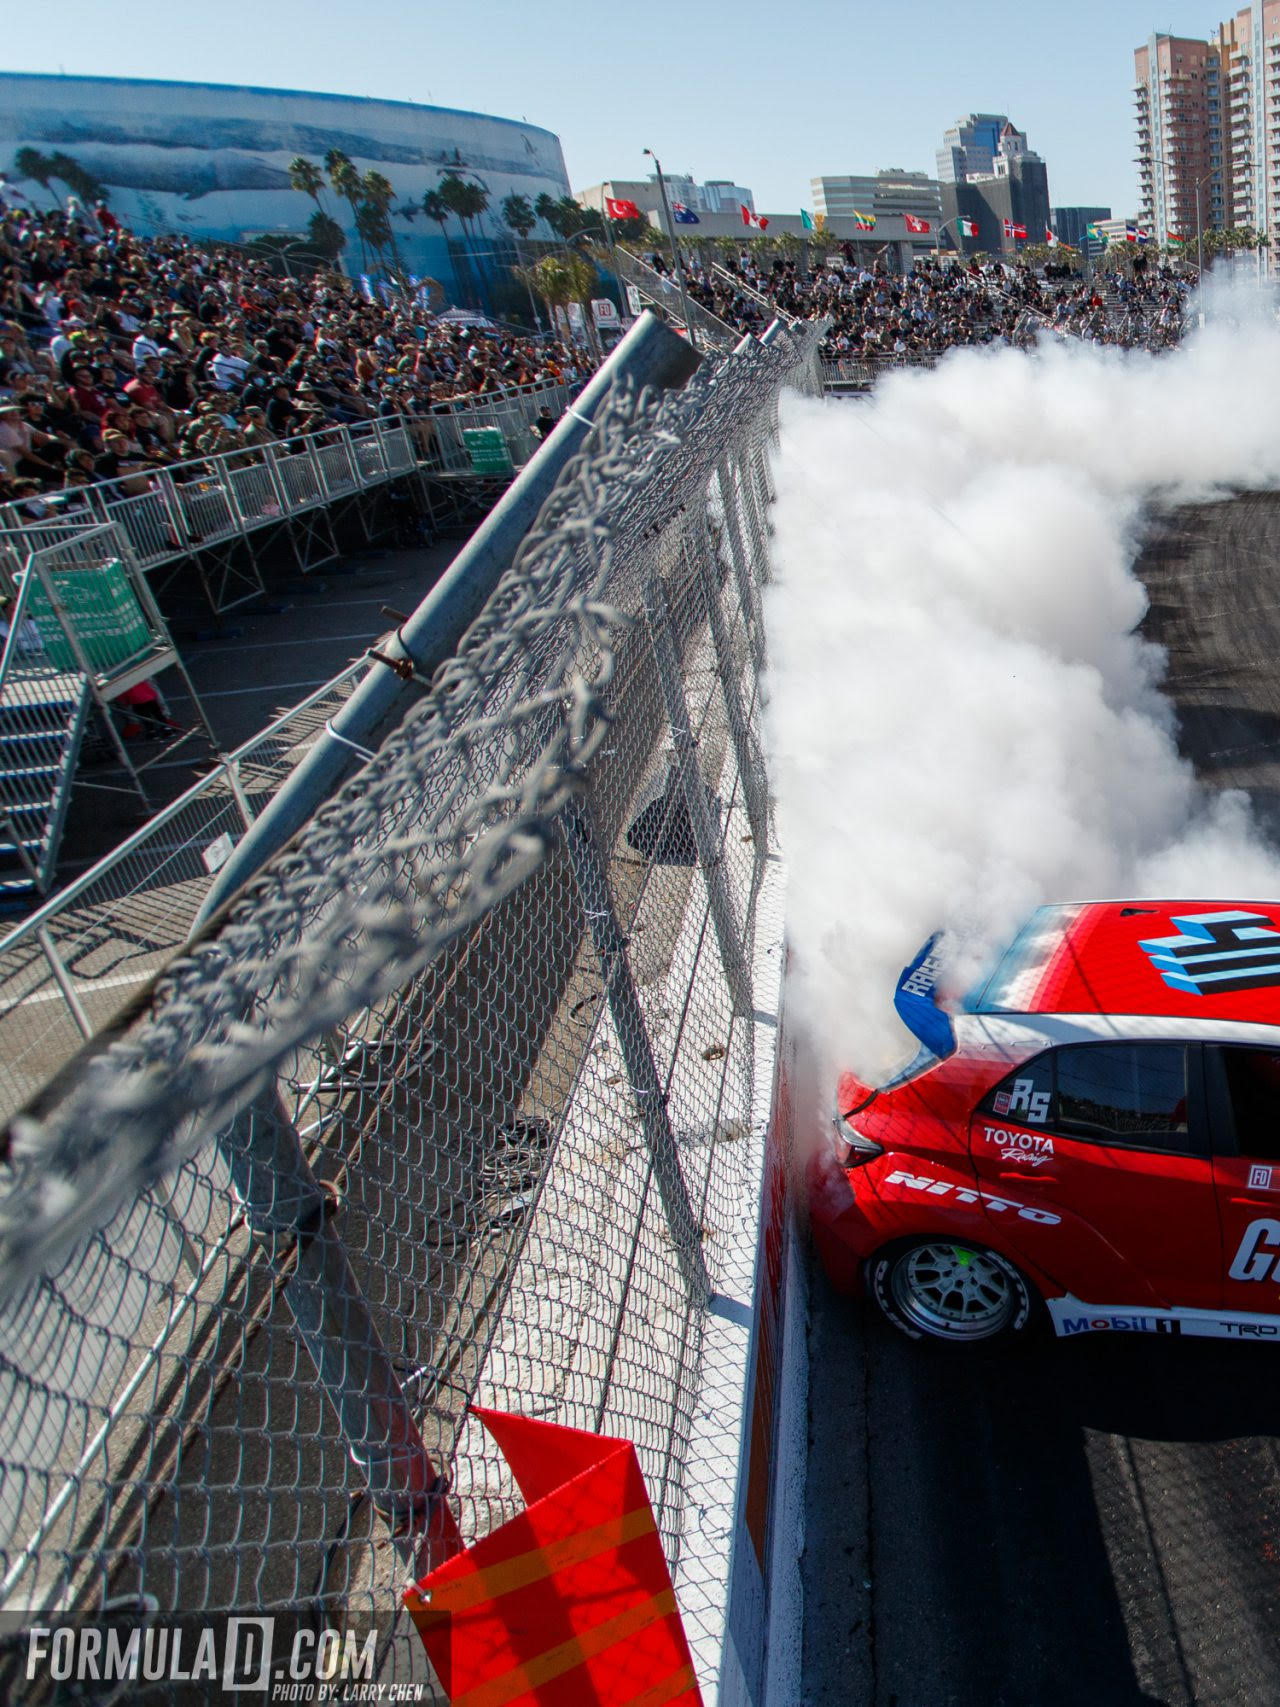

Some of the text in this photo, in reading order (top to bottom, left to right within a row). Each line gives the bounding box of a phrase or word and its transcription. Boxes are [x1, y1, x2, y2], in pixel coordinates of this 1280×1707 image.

[984, 1127, 1054, 1154] TOYOTA
[1001, 1147, 1054, 1167] Racing
[1253, 1170, 1269, 1186] FD
[884, 1170, 1062, 1225] NITTO
[1062, 1317, 1148, 1334] Mobil
[1220, 1322, 1278, 1337] TRD
